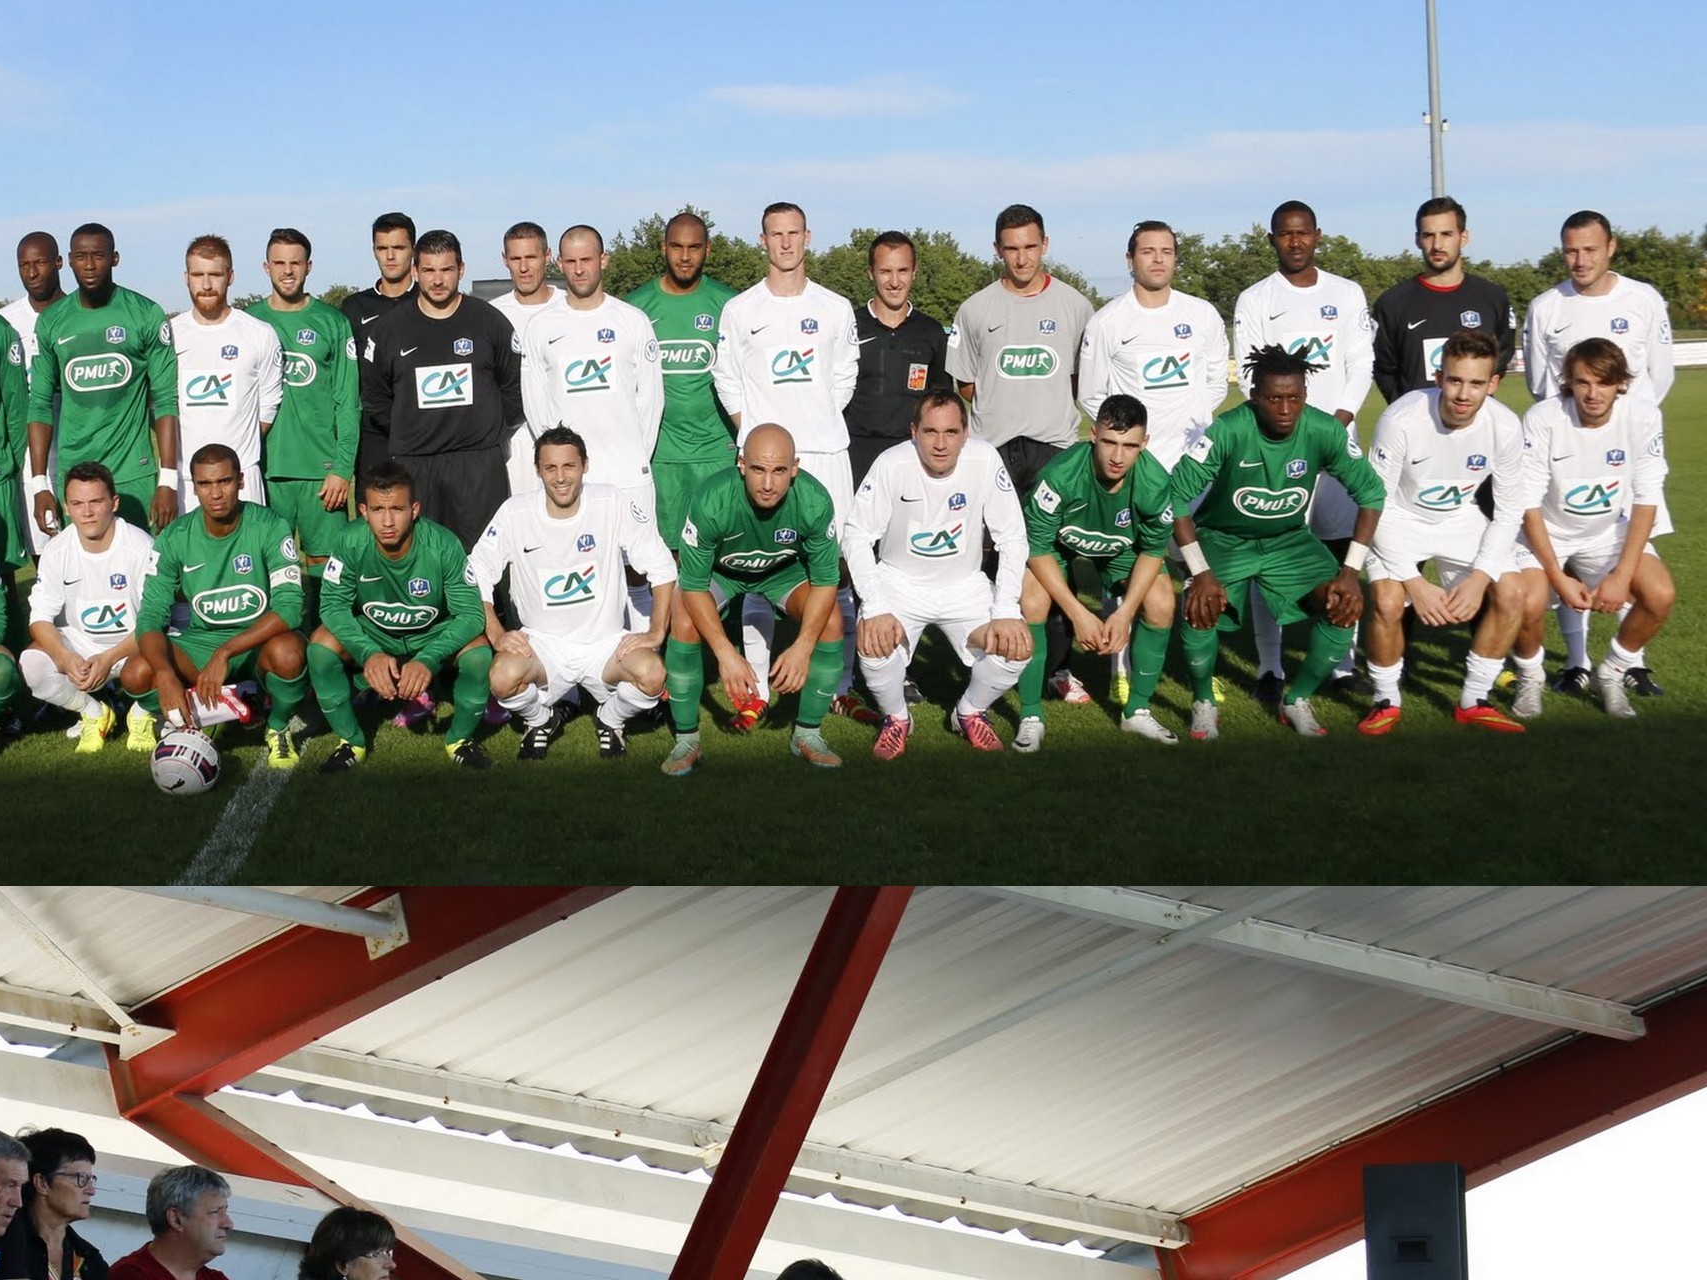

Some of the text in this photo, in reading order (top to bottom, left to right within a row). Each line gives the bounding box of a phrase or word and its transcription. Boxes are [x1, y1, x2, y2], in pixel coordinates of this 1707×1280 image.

[1003, 354, 1036, 369] PMU
[74, 363, 108, 381] PMU
[1243, 494, 1283, 511] PMU
[1066, 534, 1107, 551] PMU
[731, 558, 767, 568] PMU
[202, 598, 238, 615] PMU
[373, 608, 411, 624] PMU
